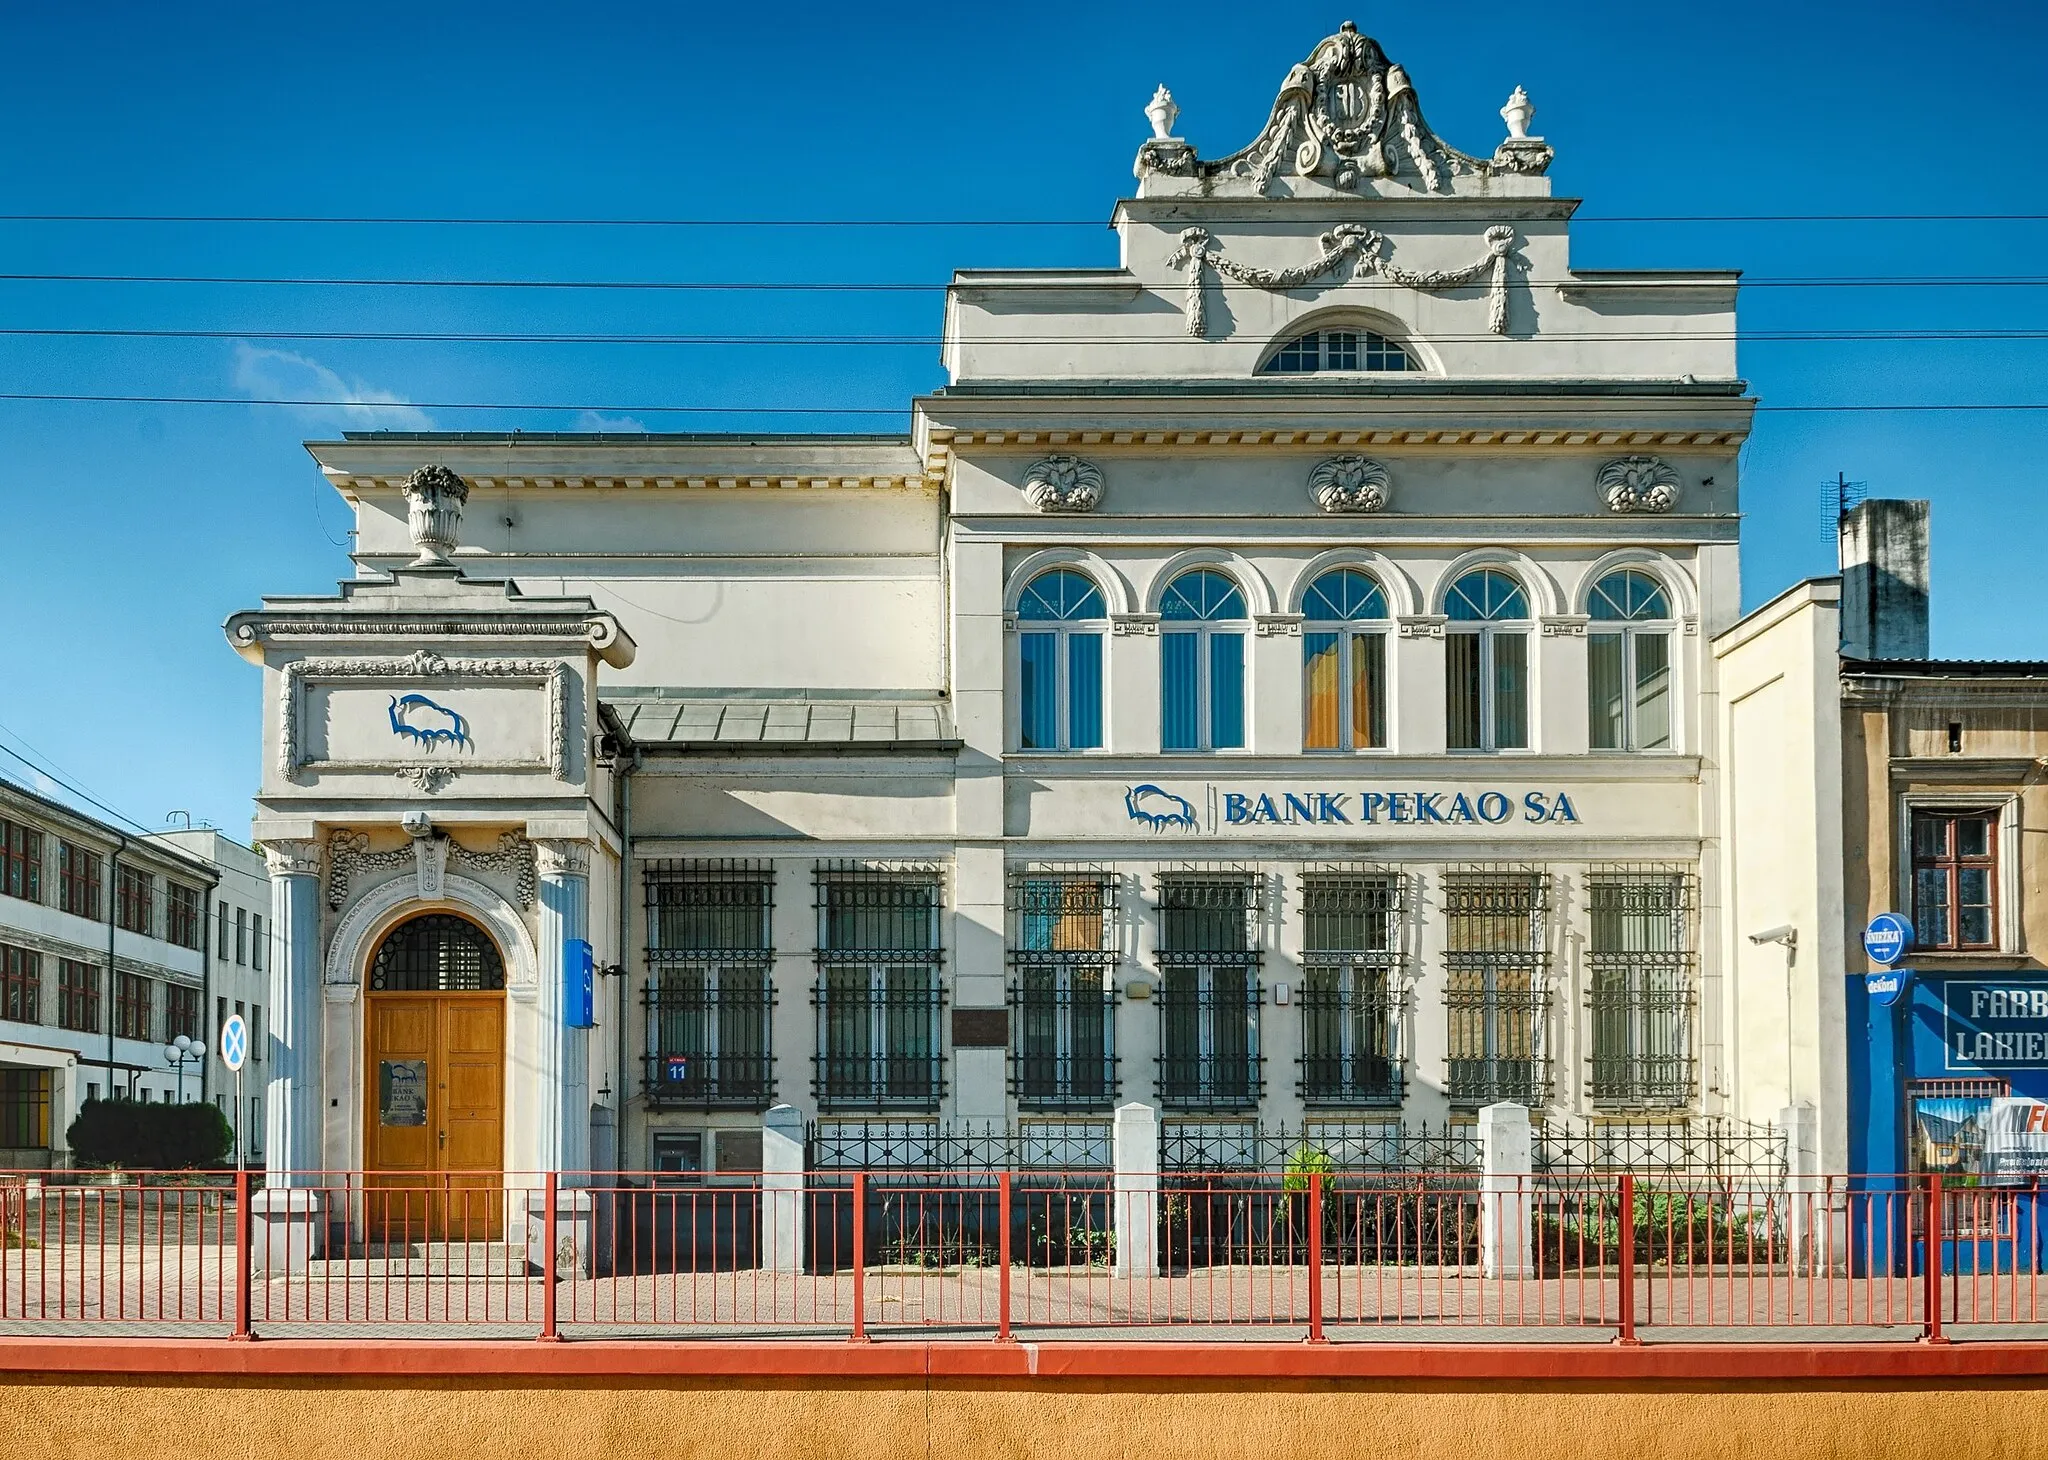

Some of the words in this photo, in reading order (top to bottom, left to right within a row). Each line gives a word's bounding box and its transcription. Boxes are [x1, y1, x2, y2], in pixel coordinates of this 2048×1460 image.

[1222, 792, 1347, 822] BANK
[1359, 791, 1509, 822] PEKAO
[1523, 791, 1578, 822] SA
[1970, 990, 2048, 1018] FARB
[670, 1065, 685, 1079] 11
